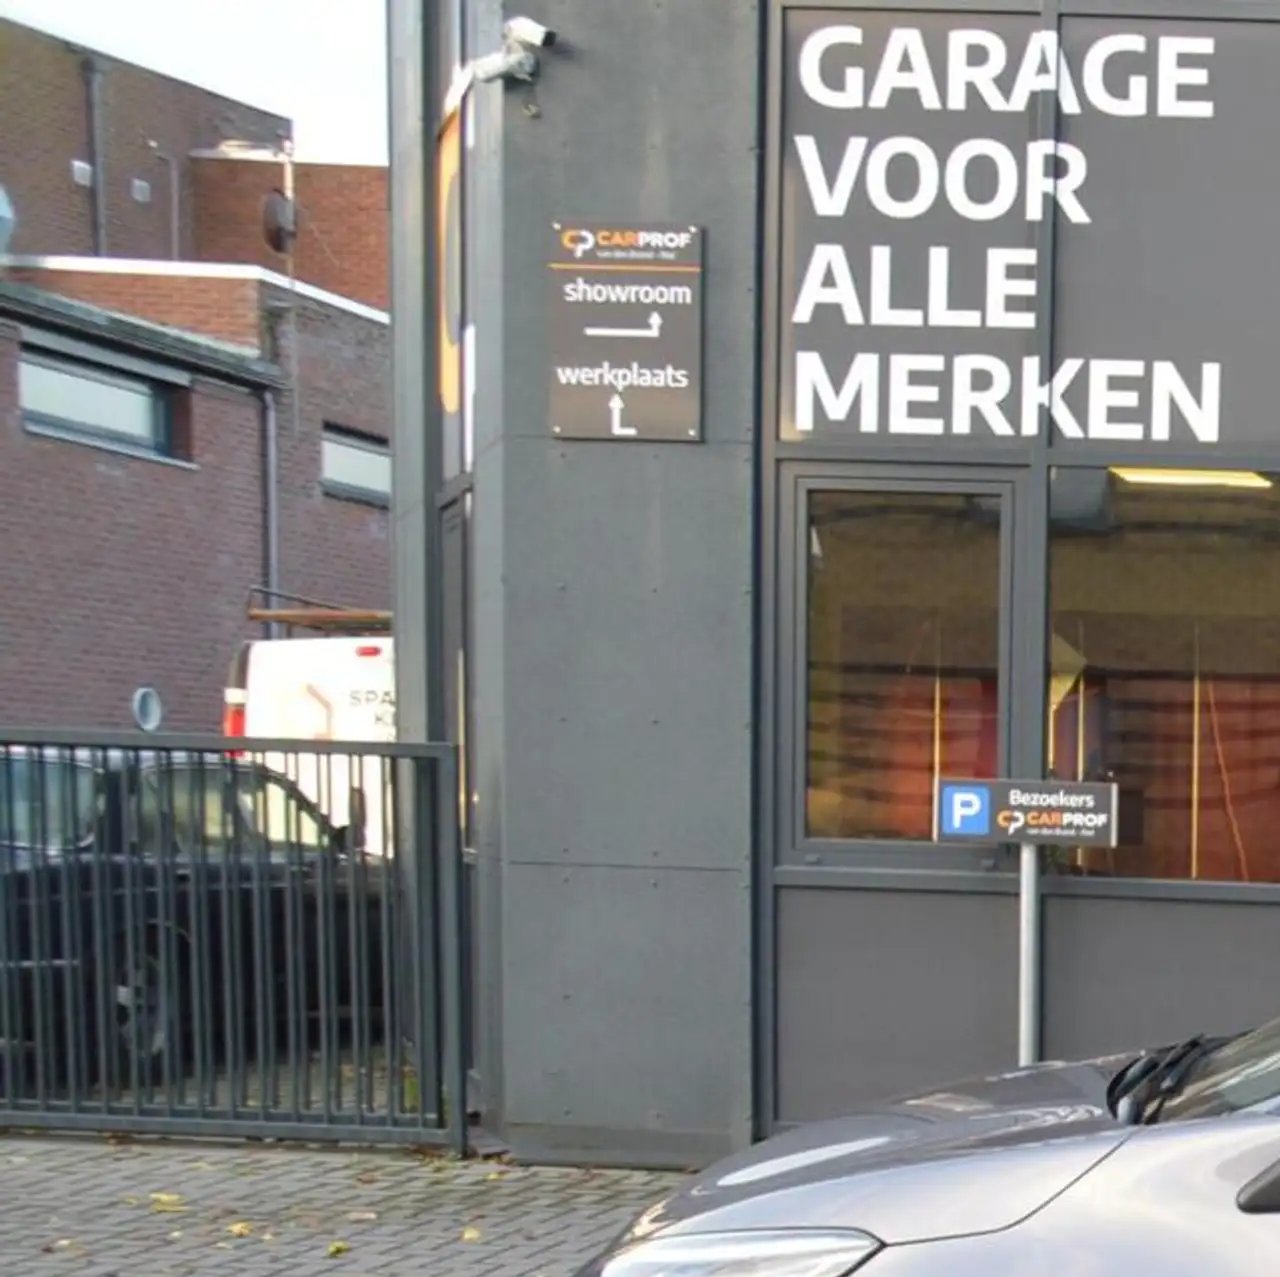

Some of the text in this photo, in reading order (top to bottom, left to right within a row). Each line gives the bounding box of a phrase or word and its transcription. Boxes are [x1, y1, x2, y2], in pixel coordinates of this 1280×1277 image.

[798, 25, 1215, 118] GARAGE
[794, 135, 1092, 224] VOOR
[596, 230, 693, 248] CARPROF
[563, 277, 692, 305] showroom
[792, 243, 1036, 328] ALLE
[556, 361, 690, 392] werkplaats
[794, 350, 1222, 444] MERKEN
[1009, 788, 1095, 808] Bezoekers
[1026, 810, 1109, 828] CARPROF
